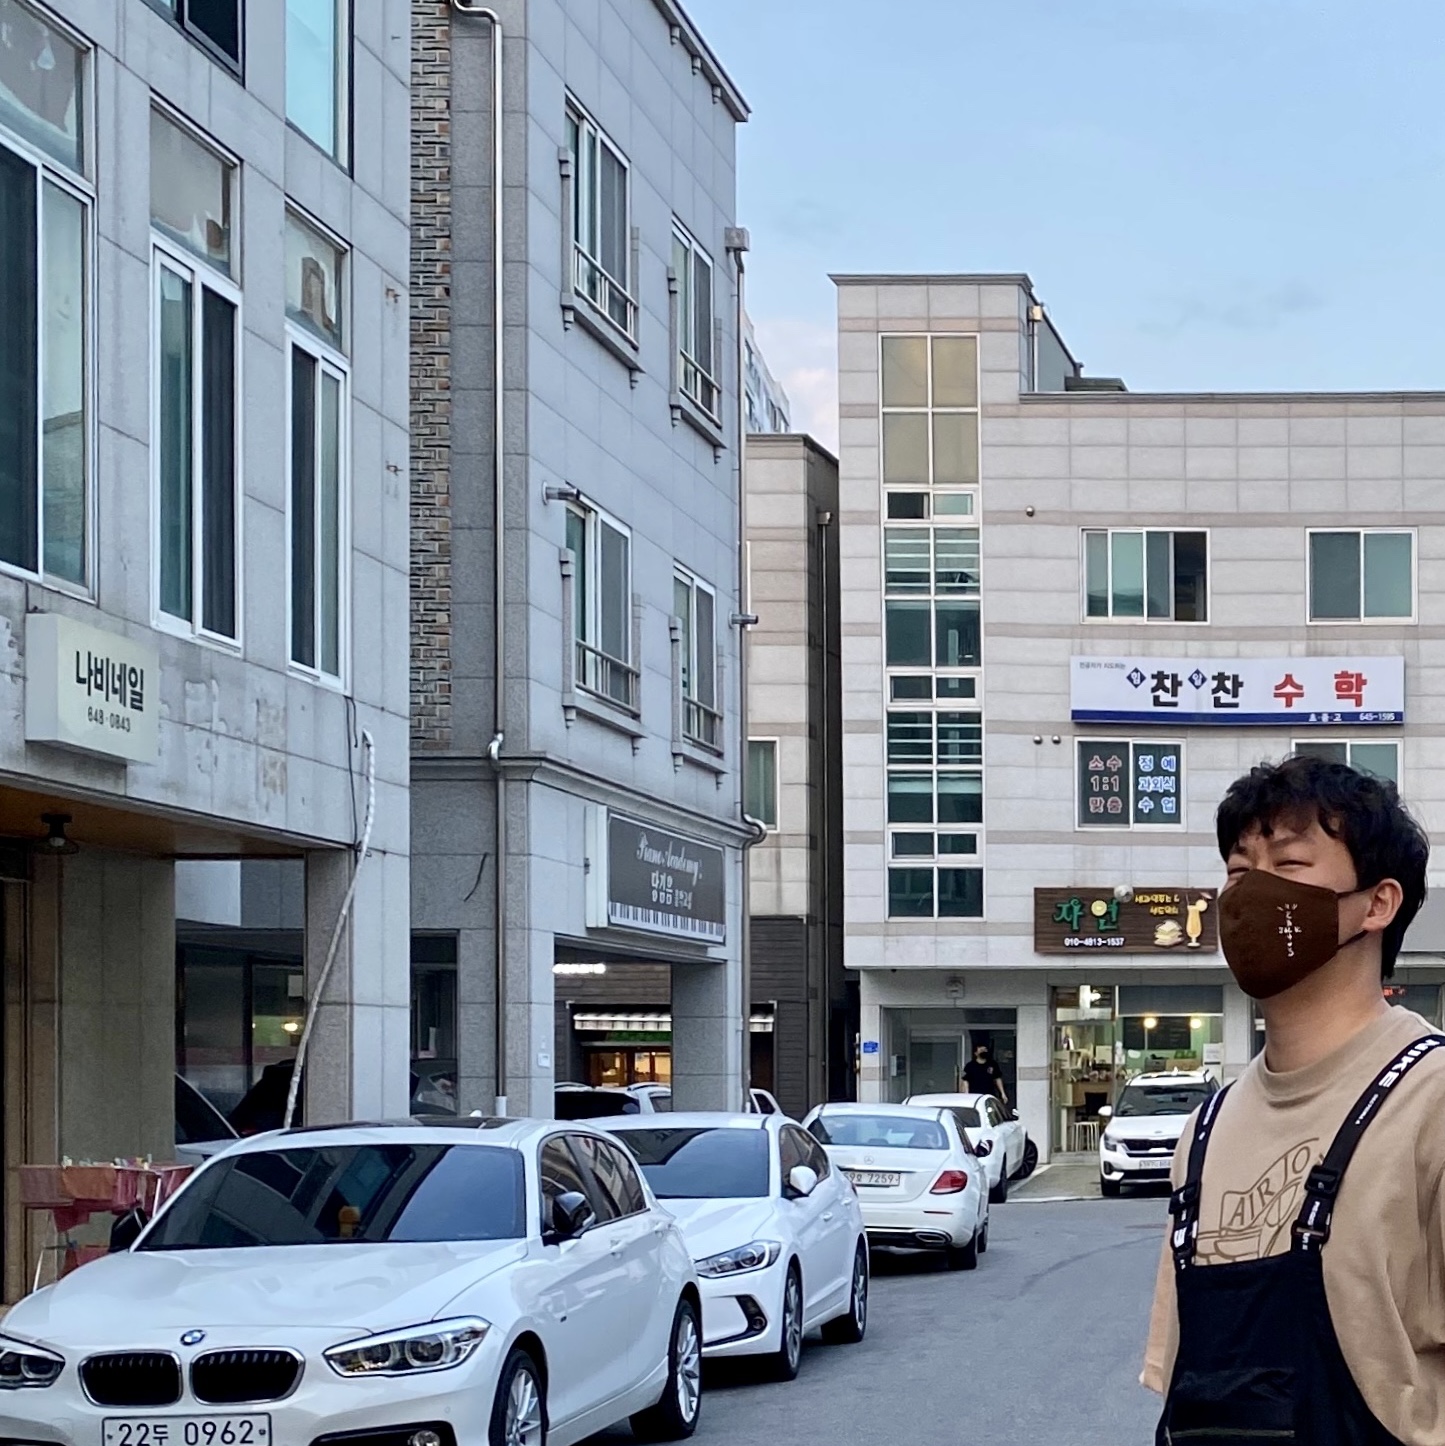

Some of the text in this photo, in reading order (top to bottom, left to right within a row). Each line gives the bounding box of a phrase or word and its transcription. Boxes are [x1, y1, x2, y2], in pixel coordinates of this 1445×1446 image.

[75, 650, 144, 712] 나비네일
[1090, 775, 1119, 791] 1:1
[1378, 1038, 1441, 1088] NIKE
[868, 1173, 893, 1183] 7259
[1227, 1177, 1275, 1226] AIR
[184, 1420, 254, 1446] 0962
